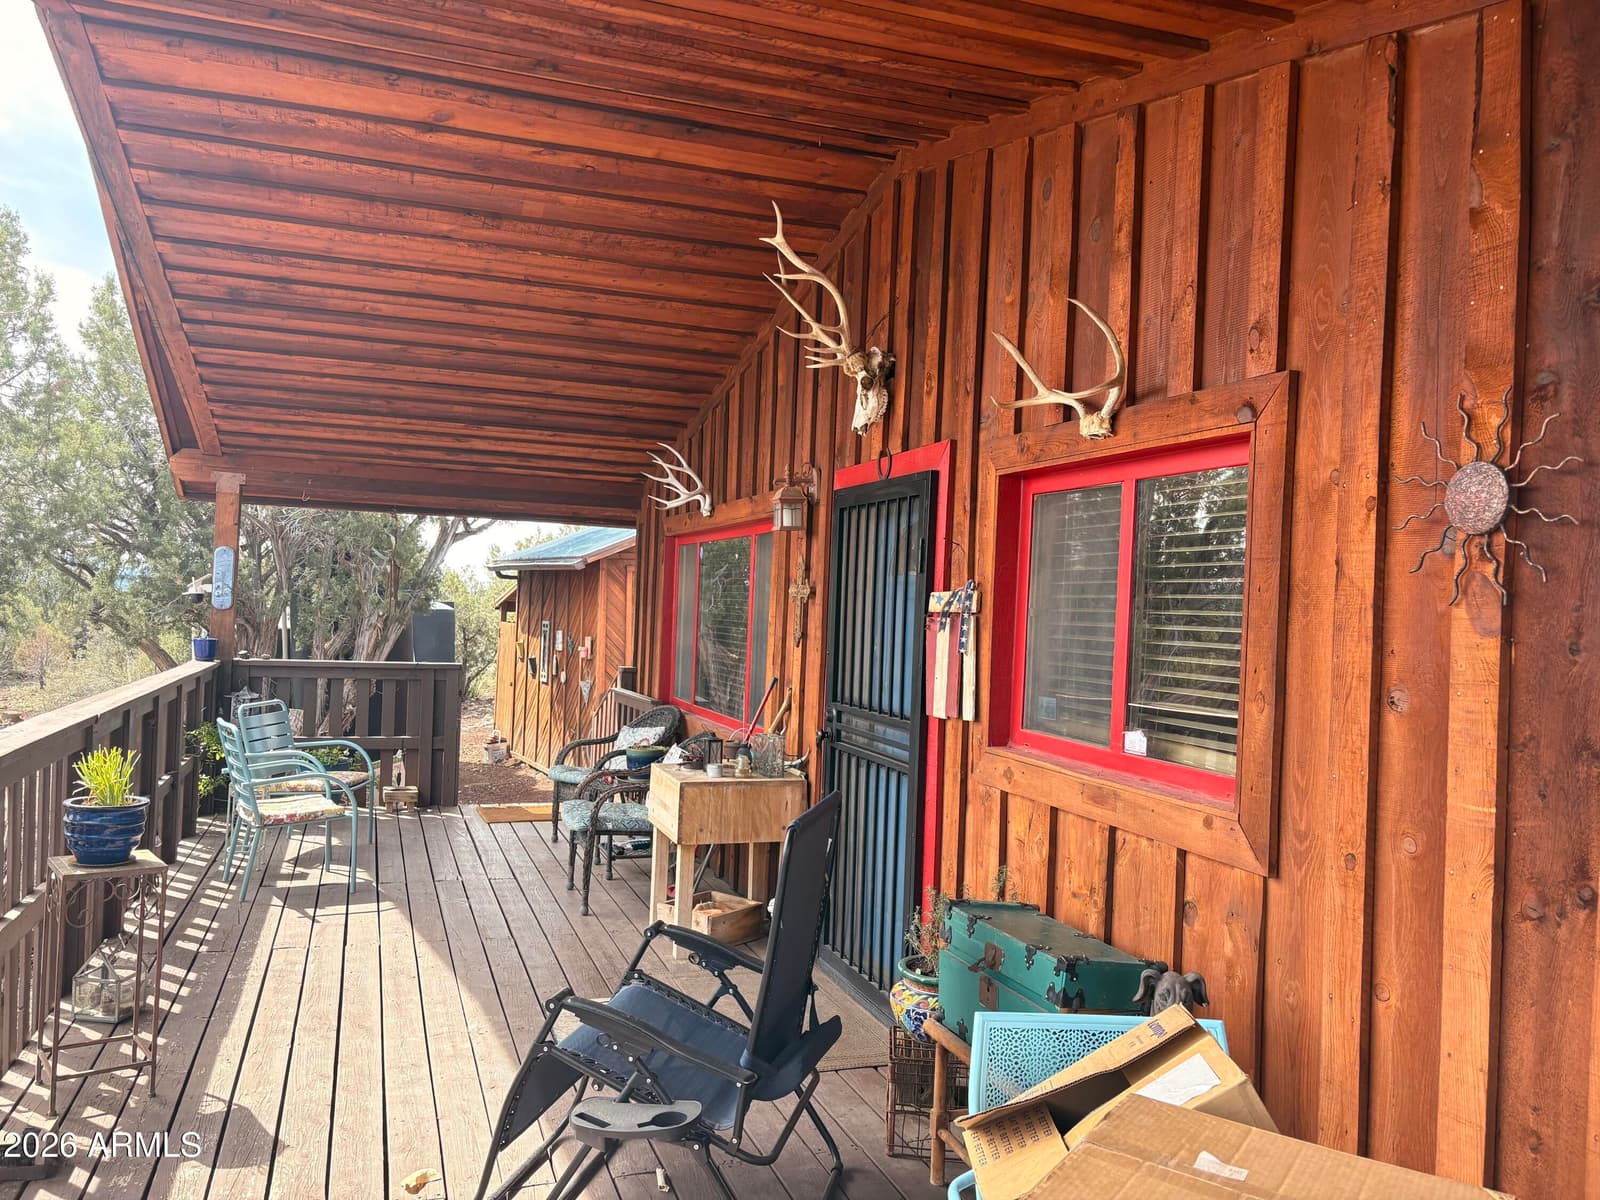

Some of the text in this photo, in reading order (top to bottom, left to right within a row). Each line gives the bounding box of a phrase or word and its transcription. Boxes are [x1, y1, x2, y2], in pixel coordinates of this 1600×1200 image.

[1012, 1126, 1026, 1148] BETTER
[1025, 1121, 1039, 1143] BETTER
[1037, 1115, 1052, 1137] BETTER
[987, 1137, 1000, 1160] BETTER
[1000, 1132, 1014, 1154] BETTER
[974, 1143, 988, 1166] BETTER
